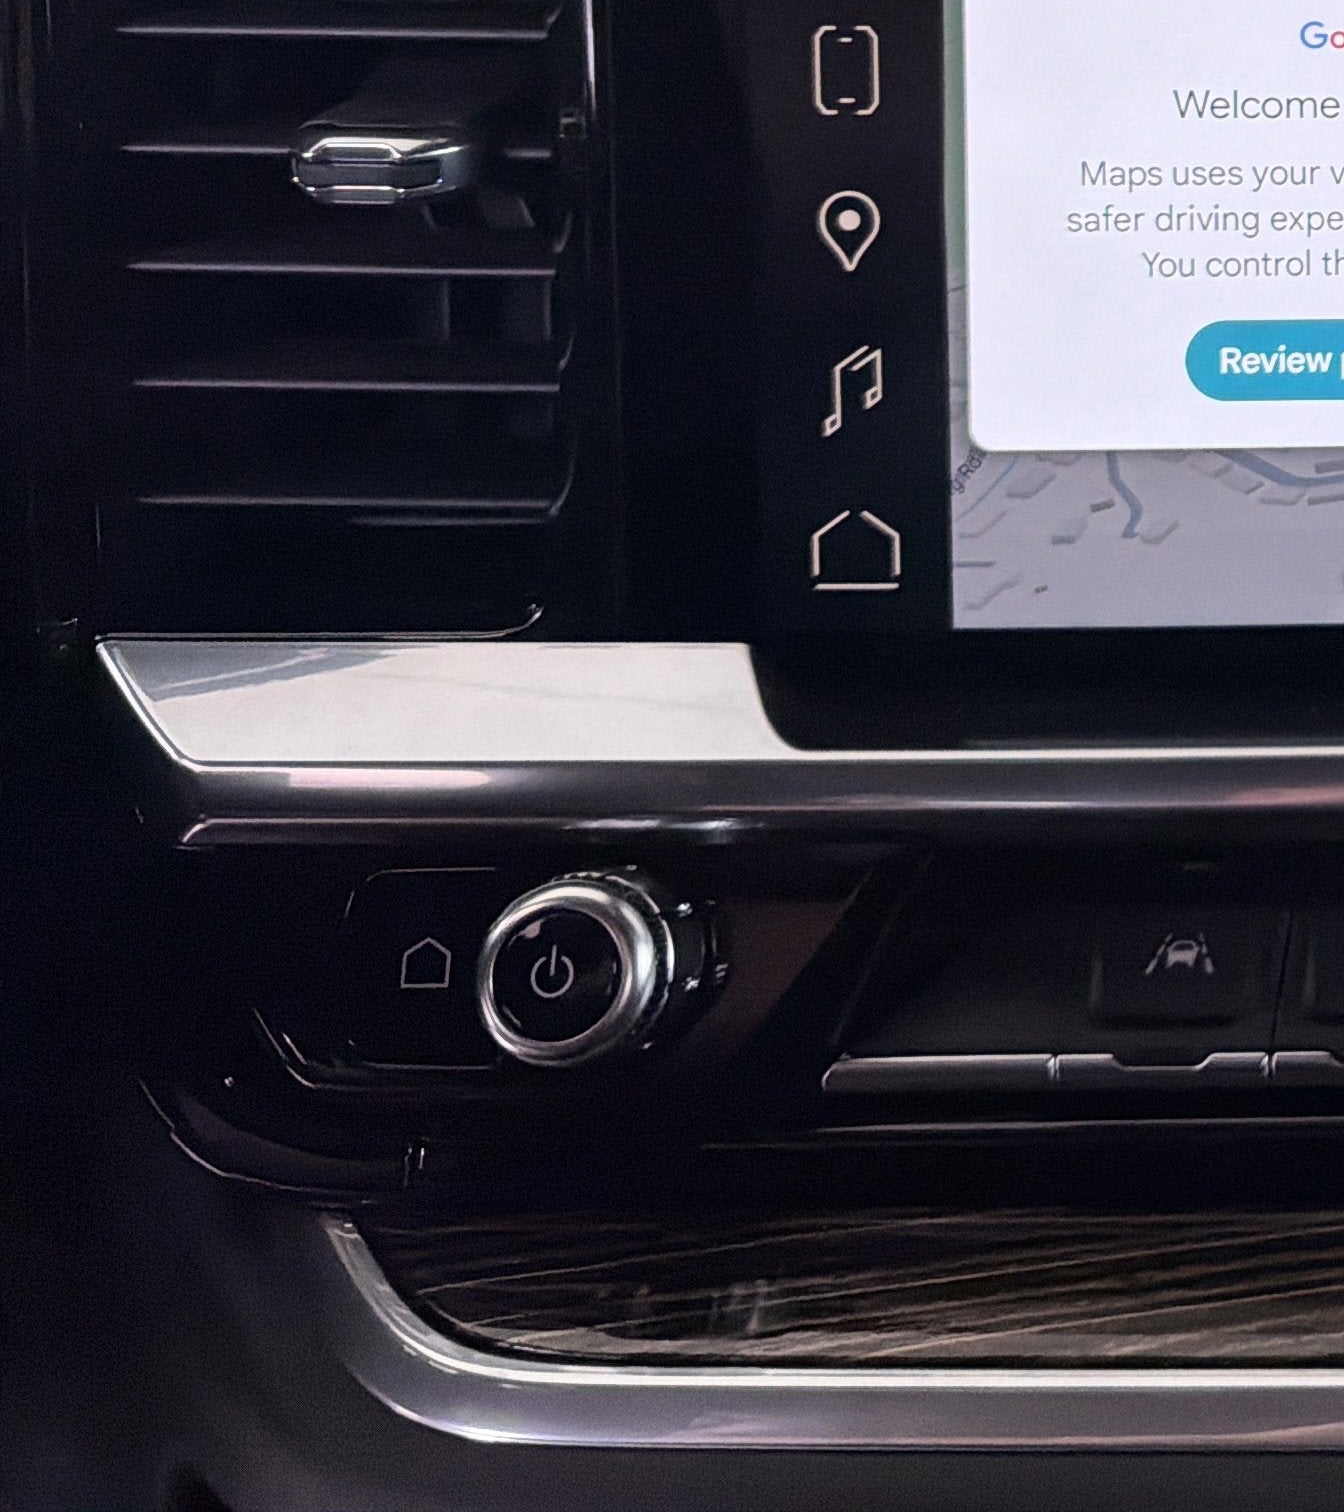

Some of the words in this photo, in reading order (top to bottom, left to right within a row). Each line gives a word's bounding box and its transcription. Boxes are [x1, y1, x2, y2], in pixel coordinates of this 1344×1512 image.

[1173, 90, 1340, 119] Welcome
[1082, 161, 1162, 193] Maps
[1173, 167, 1243, 186] uses
[1252, 166, 1320, 192] your
[1067, 204, 1145, 232] safer
[1155, 204, 1259, 238] driving
[1142, 252, 1194, 277] You
[1206, 249, 1310, 277] control
[1220, 345, 1332, 375] Review
